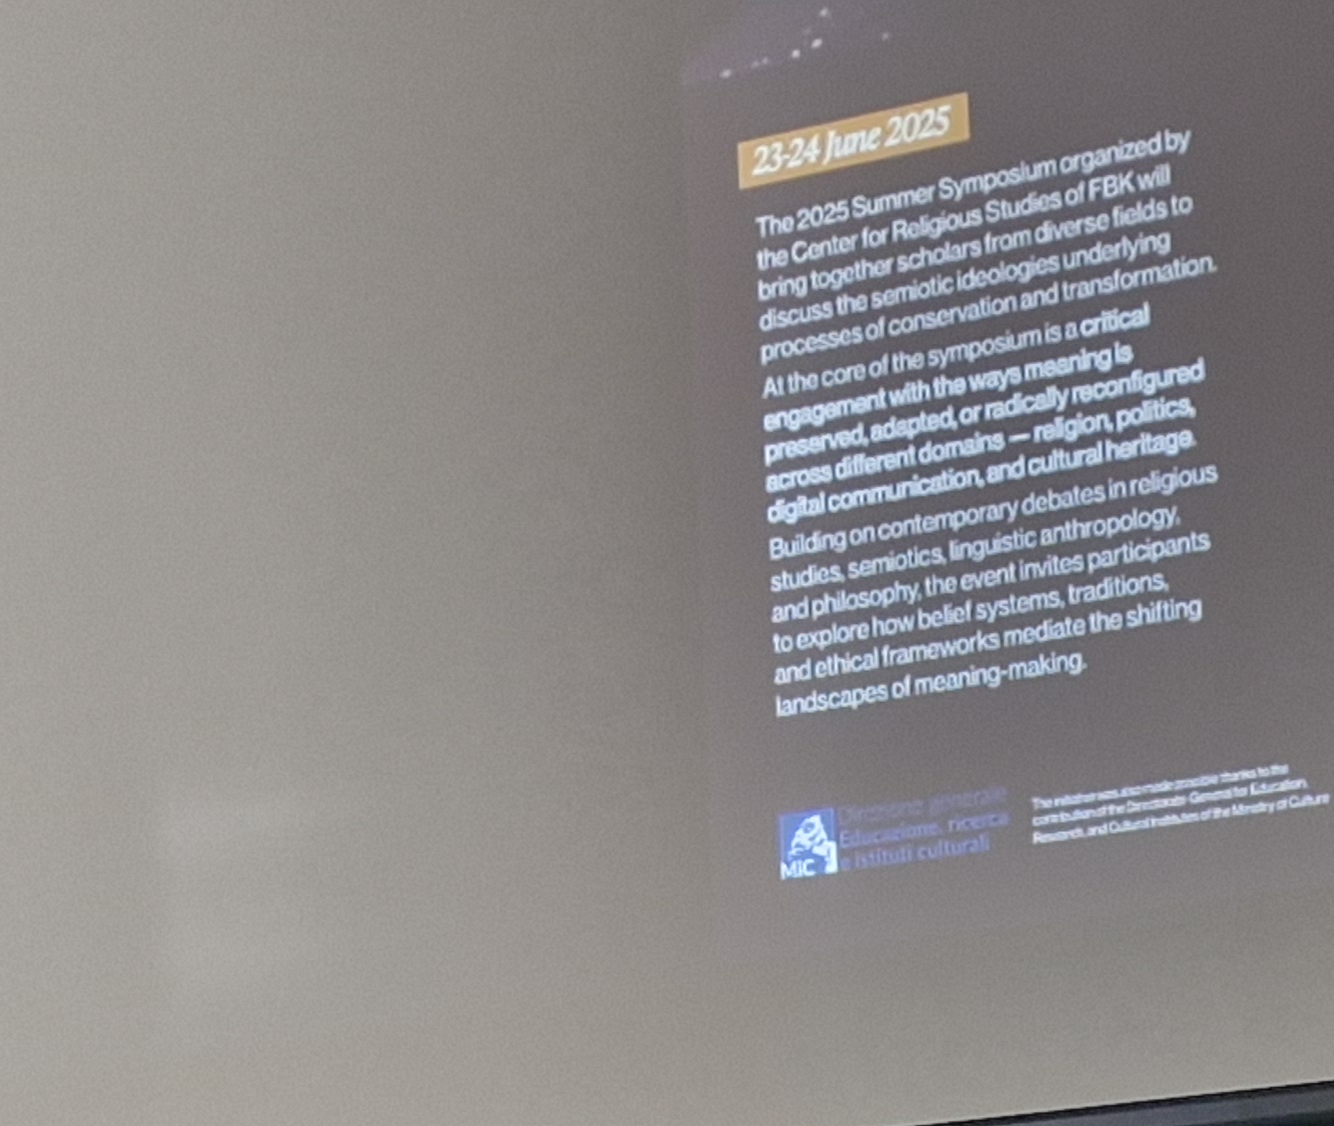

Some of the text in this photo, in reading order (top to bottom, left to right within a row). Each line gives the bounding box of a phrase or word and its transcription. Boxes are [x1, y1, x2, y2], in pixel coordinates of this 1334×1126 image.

[751, 105, 952, 176] 23-24 June 2025
[852, 131, 1163, 219] Summer Symposium organized
[757, 198, 1169, 302] bring together scholars diverse fields
[791, 170, 1135, 263] Center Religious Studies FBK
[759, 232, 1171, 332] discuss semiotic ideologies underlying
[760, 255, 1217, 366] processes conservation transformation.
[928, 301, 1151, 368] symposium critical
[763, 348, 1113, 432] engagement meaning
[763, 356, 1206, 467] preserved, adapted, radically reconfigured
[765, 396, 1197, 494] across different domains religion, politics,
[766, 429, 1197, 524] digital communication, cultural heritage.
[769, 464, 1219, 561] Building contemporary debates religious
[770, 505, 1181, 592] studies, semiotics, linguistic anthropology,
[795, 573, 1169, 651] explore belief systems, traditions,
[811, 531, 1211, 620] philosophy, event invites participants
[814, 598, 1203, 678] ethical frameworks mediate shifting
[775, 651, 1087, 718] landscapes meaning-making.
